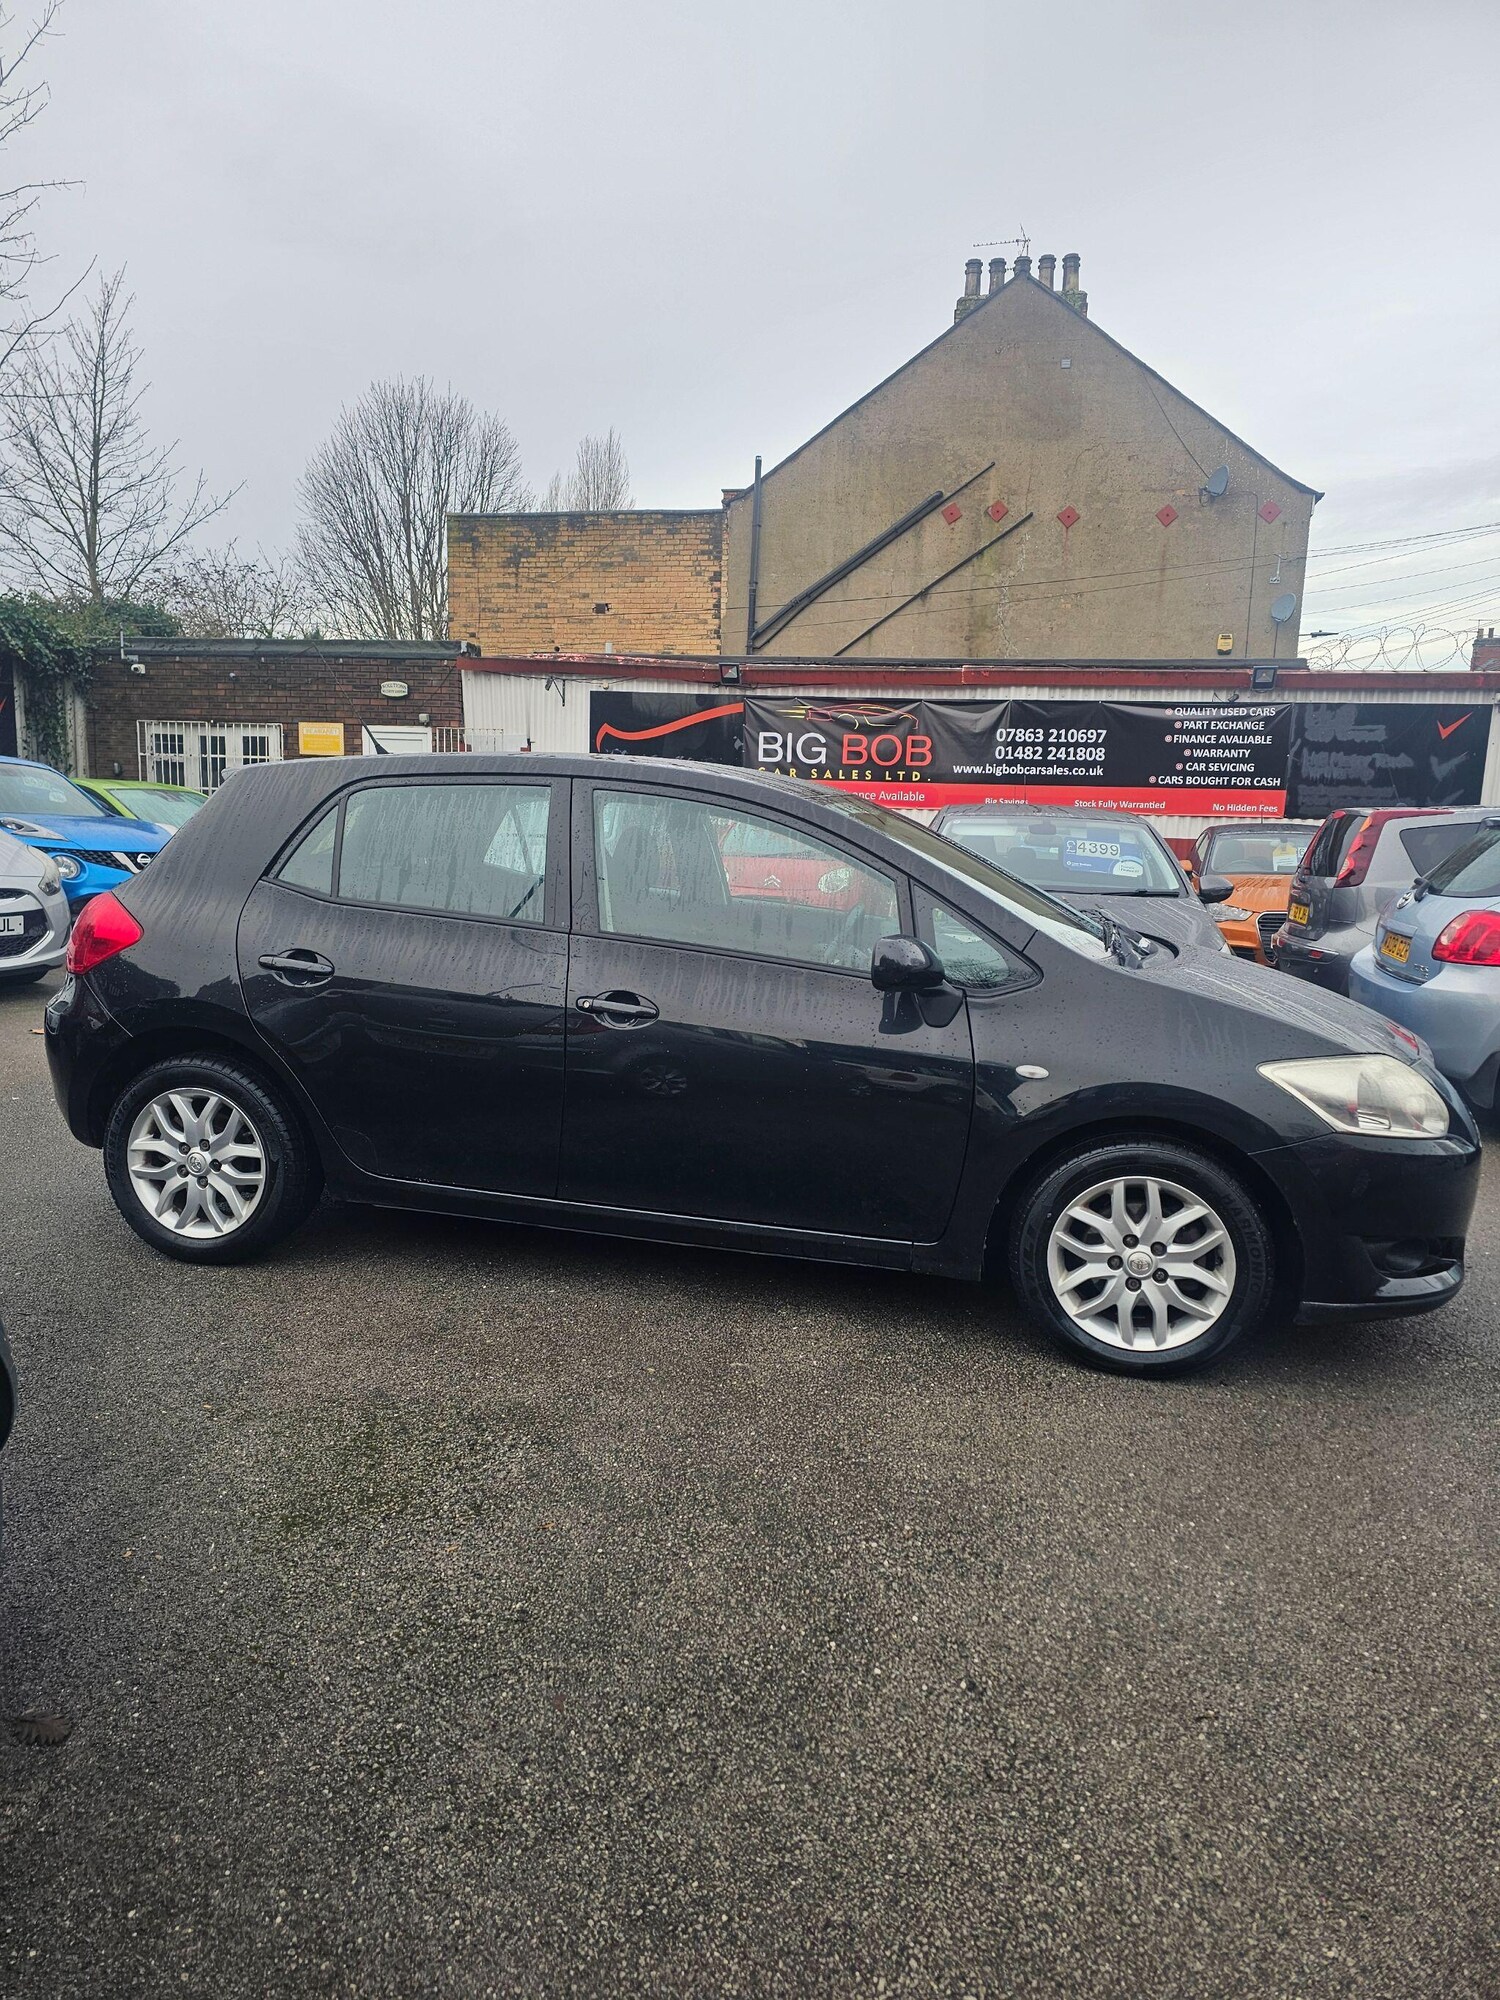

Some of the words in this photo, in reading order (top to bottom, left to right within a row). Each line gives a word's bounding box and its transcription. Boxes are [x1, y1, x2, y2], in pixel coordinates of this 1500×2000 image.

[1174, 707, 1217, 717] QUALITY
[1220, 708, 1247, 716] USED
[1249, 708, 1276, 716] CARS
[1183, 721, 1208, 730] PART
[1211, 721, 1265, 730] EXCHANGE
[996, 728, 1044, 743] 07863
[1048, 729, 1107, 743] 210697
[1173, 735, 1217, 744] FINANCE
[1218, 735, 1272, 744] AVALIABLE
[758, 731, 827, 764] BIG
[842, 734, 933, 766] BOB
[995, 746, 1043, 760] 01482
[1047, 747, 1105, 761] 241808
[1193, 749, 1251, 758] WARRANTY
[953, 764, 1103, 777] www.bigbobcarsales.co.uk
[1186, 762, 1206, 772] CAR
[1208, 763, 1255, 772] SEVICING
[811, 768, 872, 780] SALES
[885, 771, 931, 782] LTD.
[1158, 776, 1183, 785] CARS
[1185, 776, 1229, 786] BOUGHT
[1231, 777, 1252, 786] FOR
[1253, 777, 1281, 787] CASH
[878, 791, 925, 801] Available
[1074, 800, 1096, 808] Stock
[1099, 800, 1117, 810] Fully
[1119, 801, 1166, 809] Warrantied
[1212, 803, 1225, 811] No
[1227, 804, 1256, 812] Hidden
[1259, 804, 1278, 812] Fees
[1066, 840, 1119, 857] £4399
